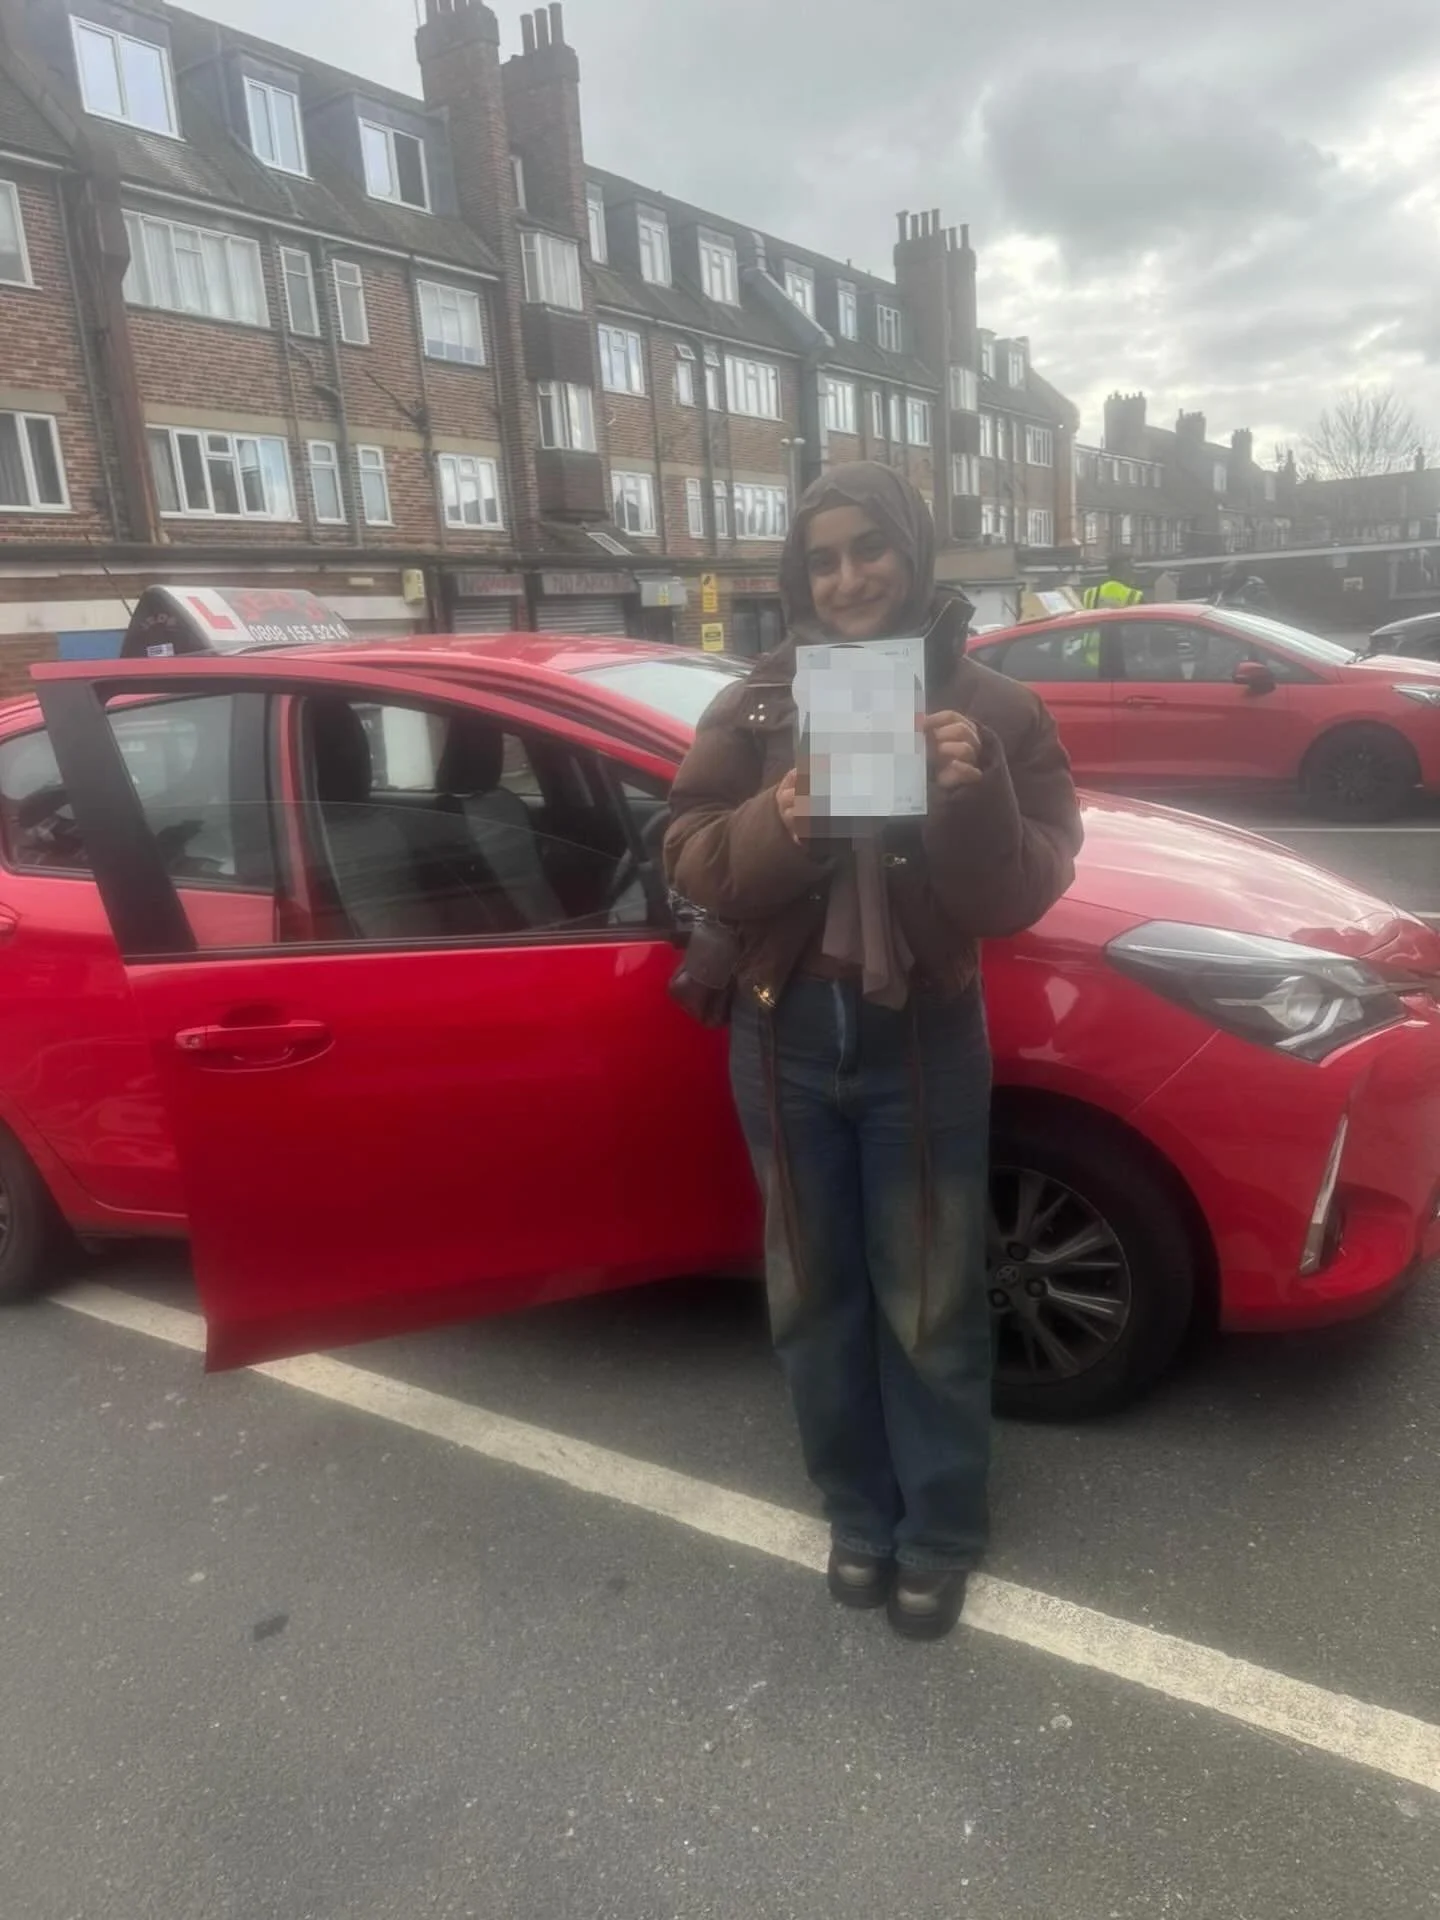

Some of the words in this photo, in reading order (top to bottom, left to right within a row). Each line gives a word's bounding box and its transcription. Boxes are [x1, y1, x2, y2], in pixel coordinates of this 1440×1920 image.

[187, 595, 235, 630] L
[247, 624, 288, 641] 0808
[286, 624, 315, 641] 155
[312, 623, 351, 640] 5214
